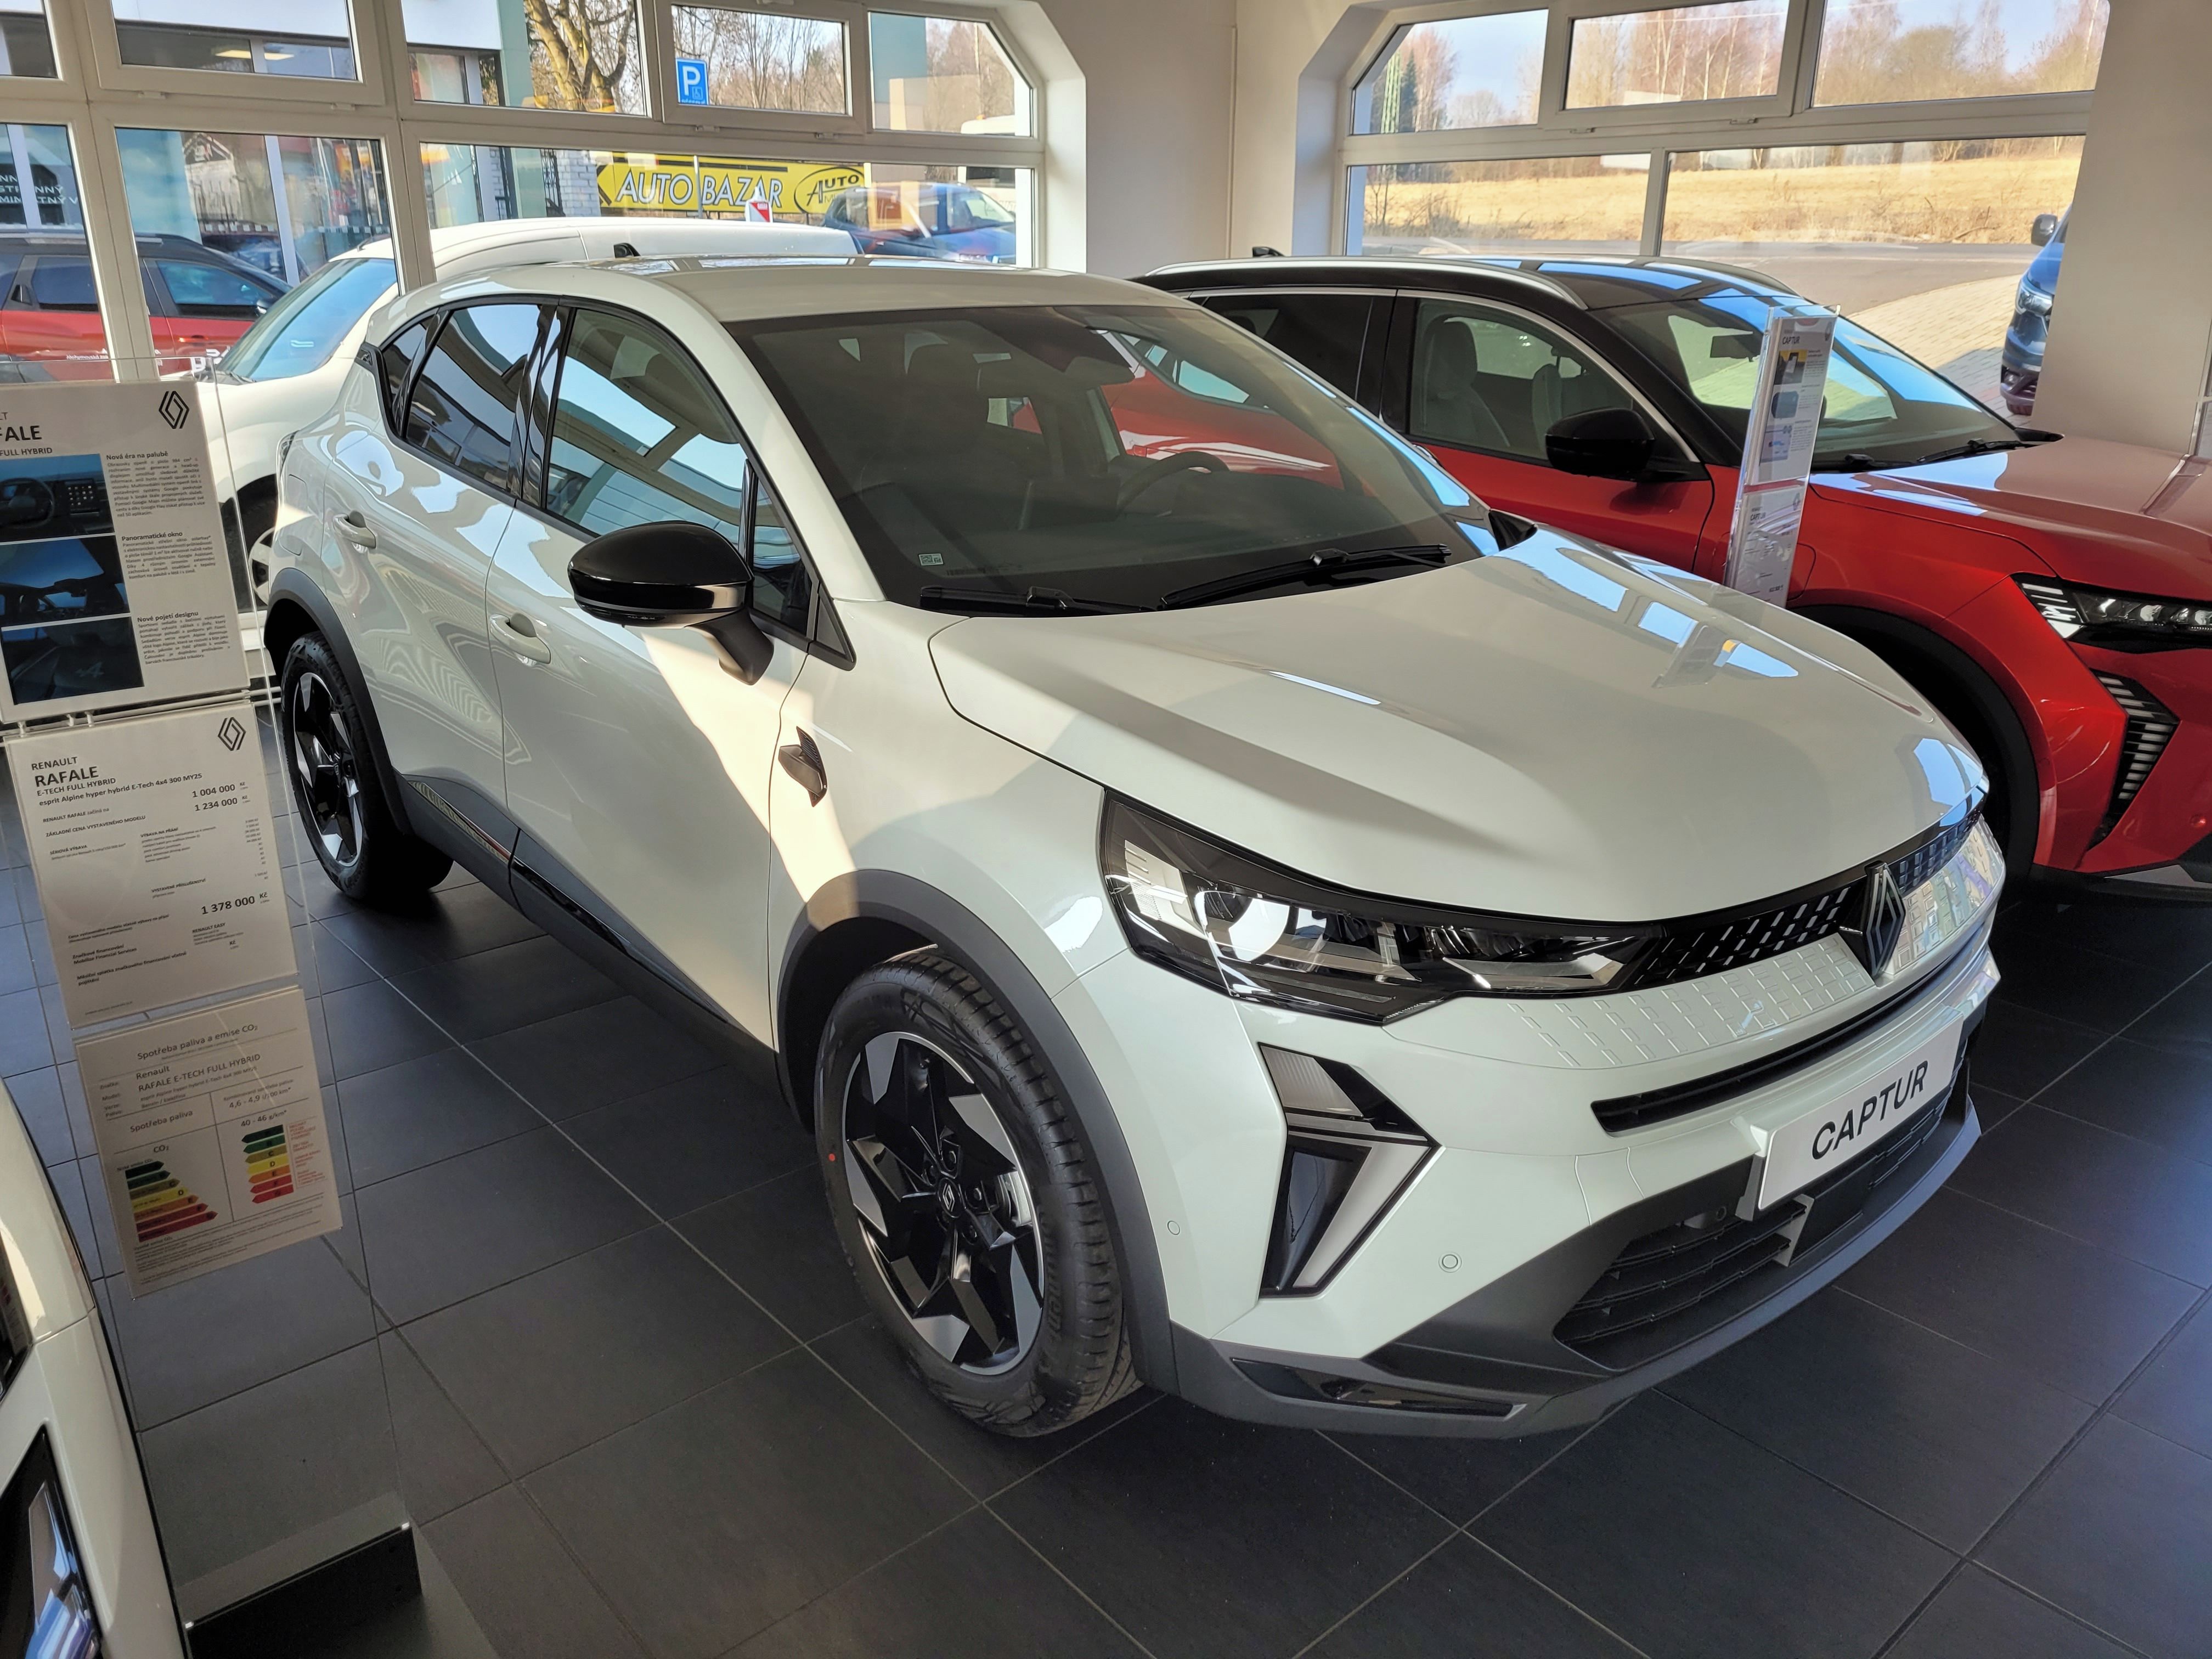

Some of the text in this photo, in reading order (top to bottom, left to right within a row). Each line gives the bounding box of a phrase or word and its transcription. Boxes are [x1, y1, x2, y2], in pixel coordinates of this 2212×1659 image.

[682, 65, 701, 96] P
[615, 168, 782, 208] AUTO BAZAR
[806, 174, 860, 206] AUTO
[1782, 336, 1800, 345] CAPTUR
[0, 425, 42, 442] ALE
[21, 447, 53, 455] HYBRID
[122, 533, 167, 541] Panoramatické
[31, 756, 78, 771] RENAULT
[34, 766, 99, 787] RAFALE
[36, 777, 116, 796] E-TECH FULL HYBRID
[38, 797, 60, 806] esprit
[60, 793, 84, 803] Alpine
[85, 789, 106, 798] hyper
[107, 785, 130, 794] hybrid
[131, 781, 154, 789] E-Tech
[183, 772, 202, 781] MY25
[199, 787, 217, 796] 004
[218, 783, 235, 793] 000
[87, 819, 123, 830] VYSTAVENÉHO
[123, 815, 146, 823] MODELU
[202, 800, 219, 810] 234
[221, 797, 238, 806] 000
[201, 906, 208, 915] 1
[211, 901, 232, 912] 378
[234, 896, 255, 907] 000
[136, 1043, 178, 1062] Spotřeba
[179, 1036, 205, 1050] paliva
[213, 1027, 240, 1040] emise
[136, 1064, 170, 1080] Renault
[138, 1076, 171, 1092] RAFALE
[173, 1068, 205, 1083] E-TECH
[206, 1062, 226, 1074] FULL
[229, 1052, 261, 1068] HYBRID
[228, 1099, 241, 1109] 4,6
[247, 1094, 261, 1104] 4,9
[1812, 1060, 1928, 1160] CAPTUR
[129, 1116, 168, 1134] Spotřeba
[168, 1108, 193, 1122] paliva
[240, 1119, 251, 1127] 40
[256, 1114, 267, 1123] 46
